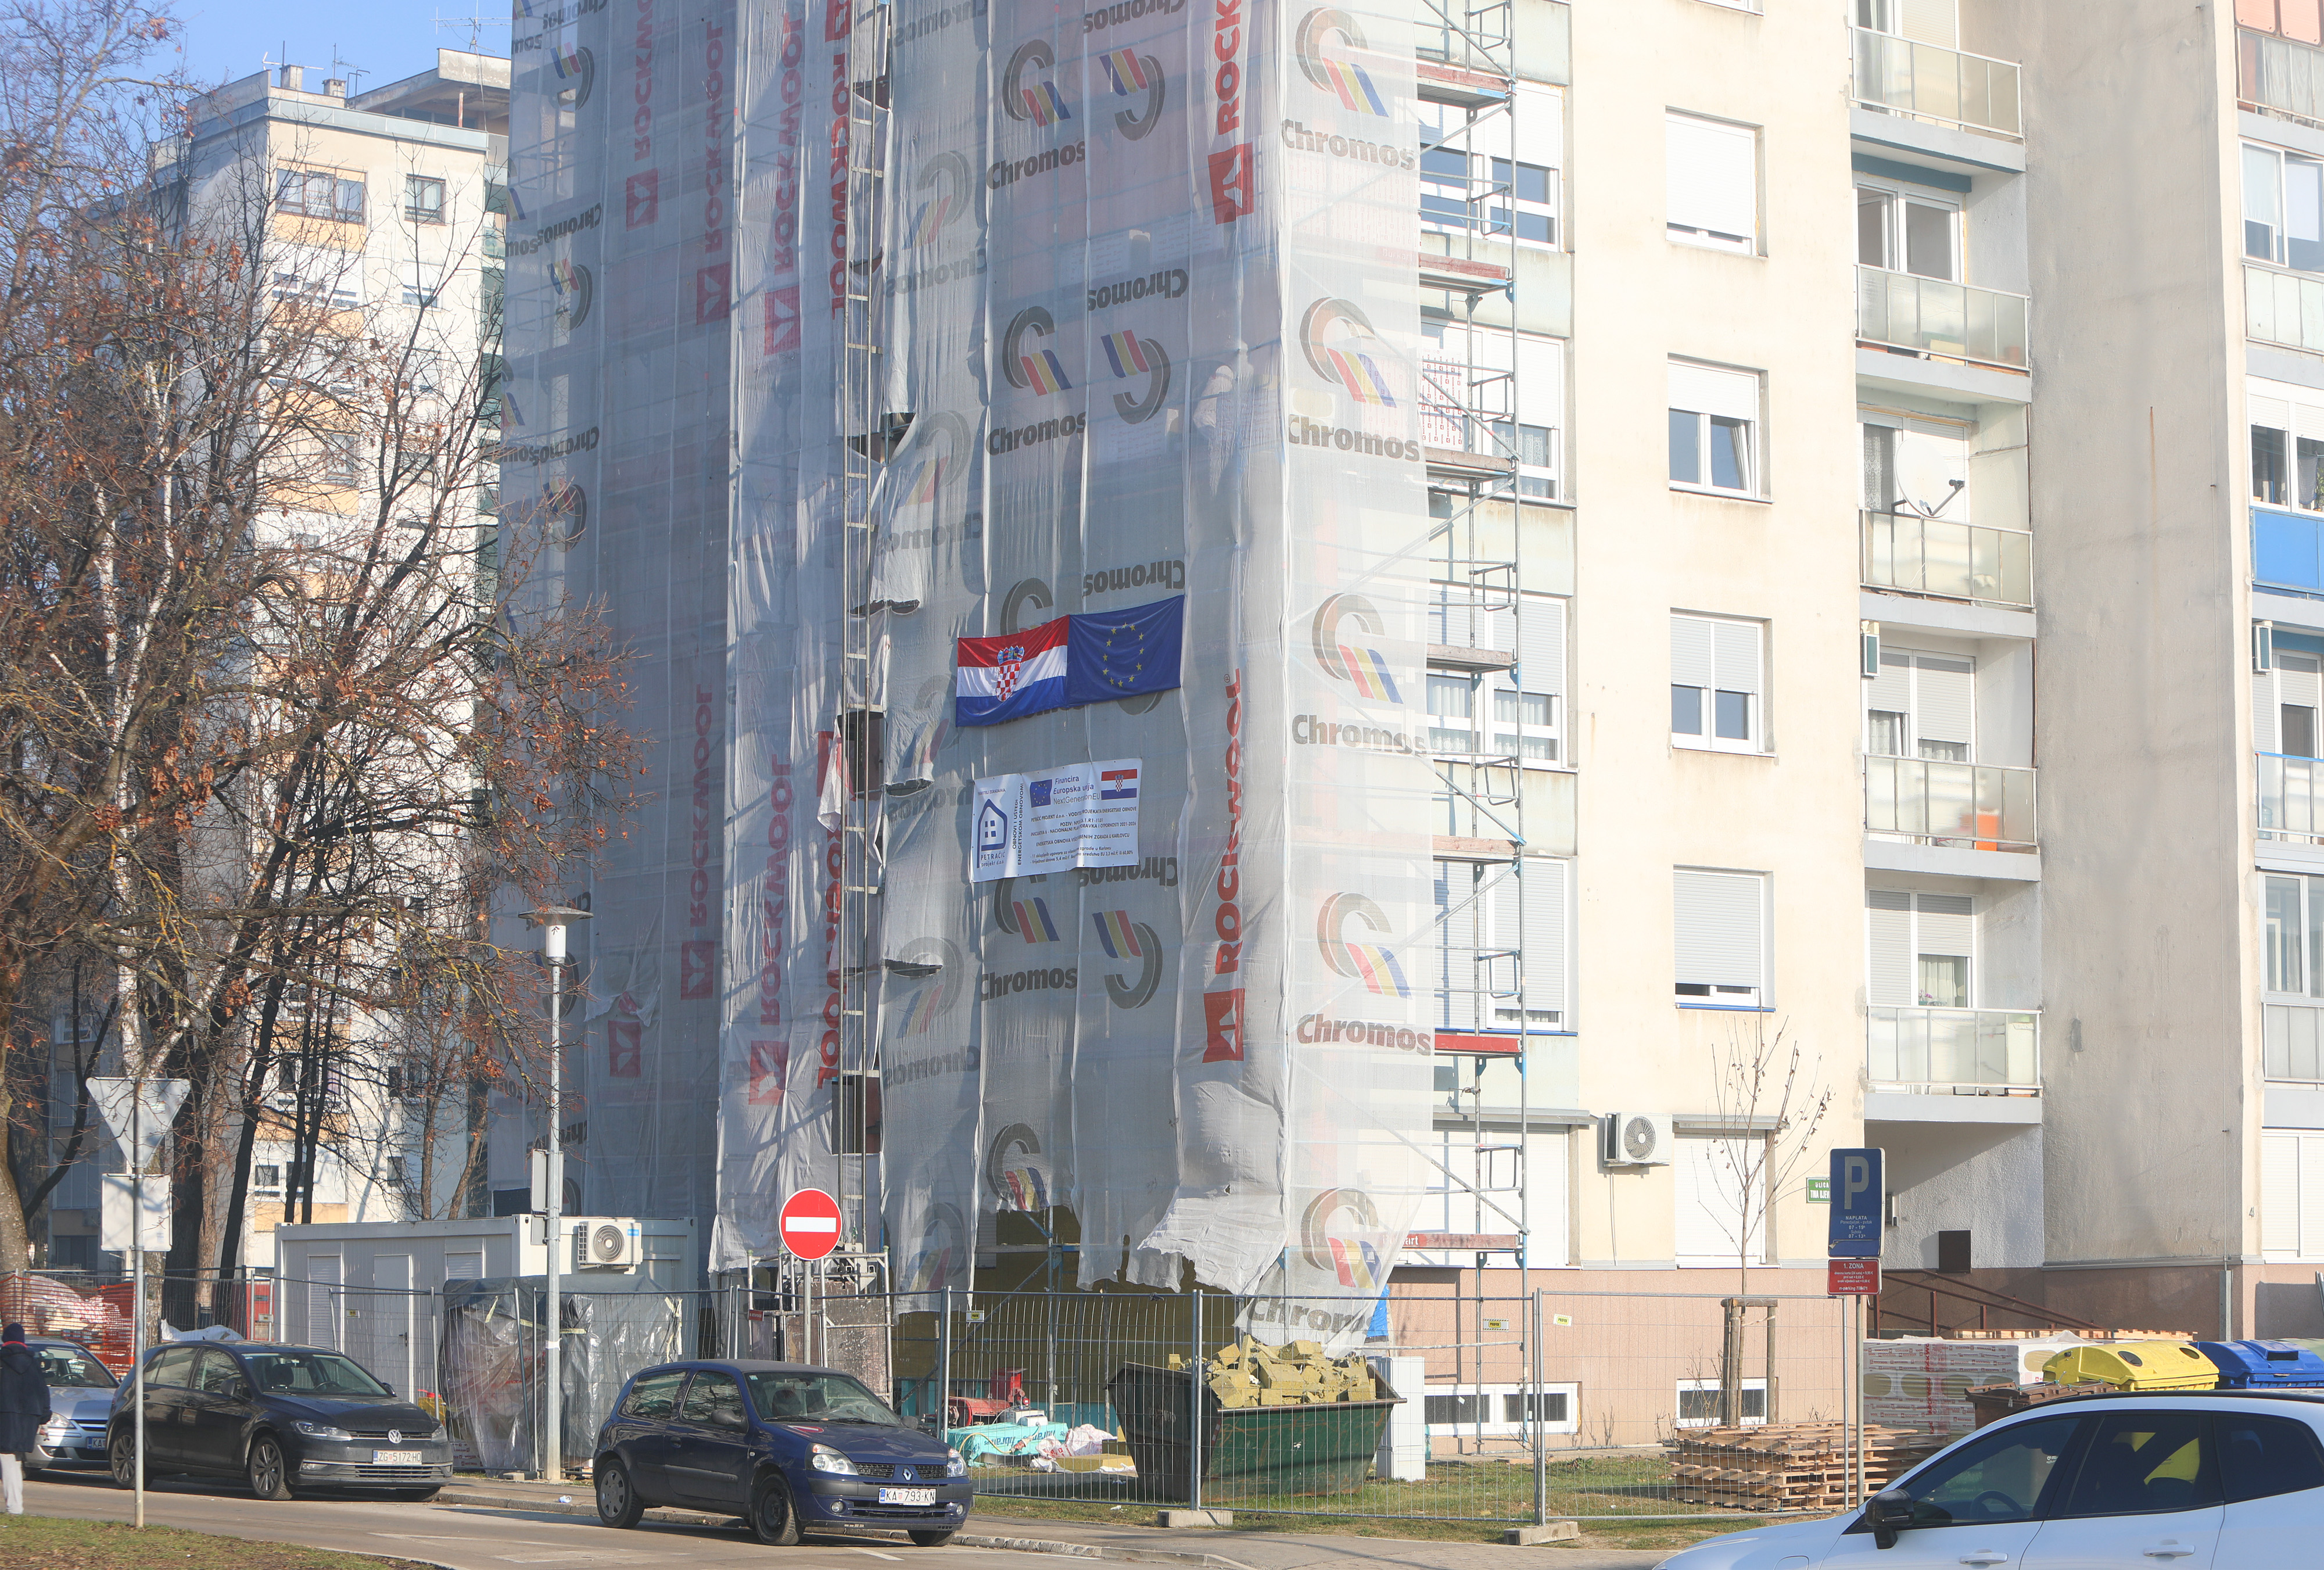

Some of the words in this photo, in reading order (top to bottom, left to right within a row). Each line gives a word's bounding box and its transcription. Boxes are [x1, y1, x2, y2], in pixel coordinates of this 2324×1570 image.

[1214, 0, 1242, 135] ROCK
[986, 141, 1086, 190] Chromos
[1282, 119, 1416, 171] Chromos
[537, 202, 603, 248] Chromos
[1088, 268, 1189, 312] Chromos
[532, 426, 600, 466] Chromos
[985, 412, 1086, 456] Chromos
[1288, 413, 1421, 463] Chromos
[1082, 560, 1186, 597] Chromos
[1292, 714, 1429, 759] Chromos
[1053, 785, 1081, 795] Europska
[1055, 775, 1079, 785] Financira
[1214, 668, 1243, 974] ROCKWOOL
[980, 851, 1005, 861] PETRAČIĆ
[981, 860, 996, 868] projekt
[1079, 856, 1178, 888] Chromos
[1297, 1013, 1432, 1057] Chromos
[1810, 1189, 1819, 1199] TINA
[1819, 1189, 1830, 1199] UJEV
[1844, 1156, 1870, 1210] P
[93, 1439, 102, 1447] KA
[379, 1452, 388, 1461] ZG
[886, 1490, 897, 1501] KA
[904, 1490, 935, 1501] 793-KN
